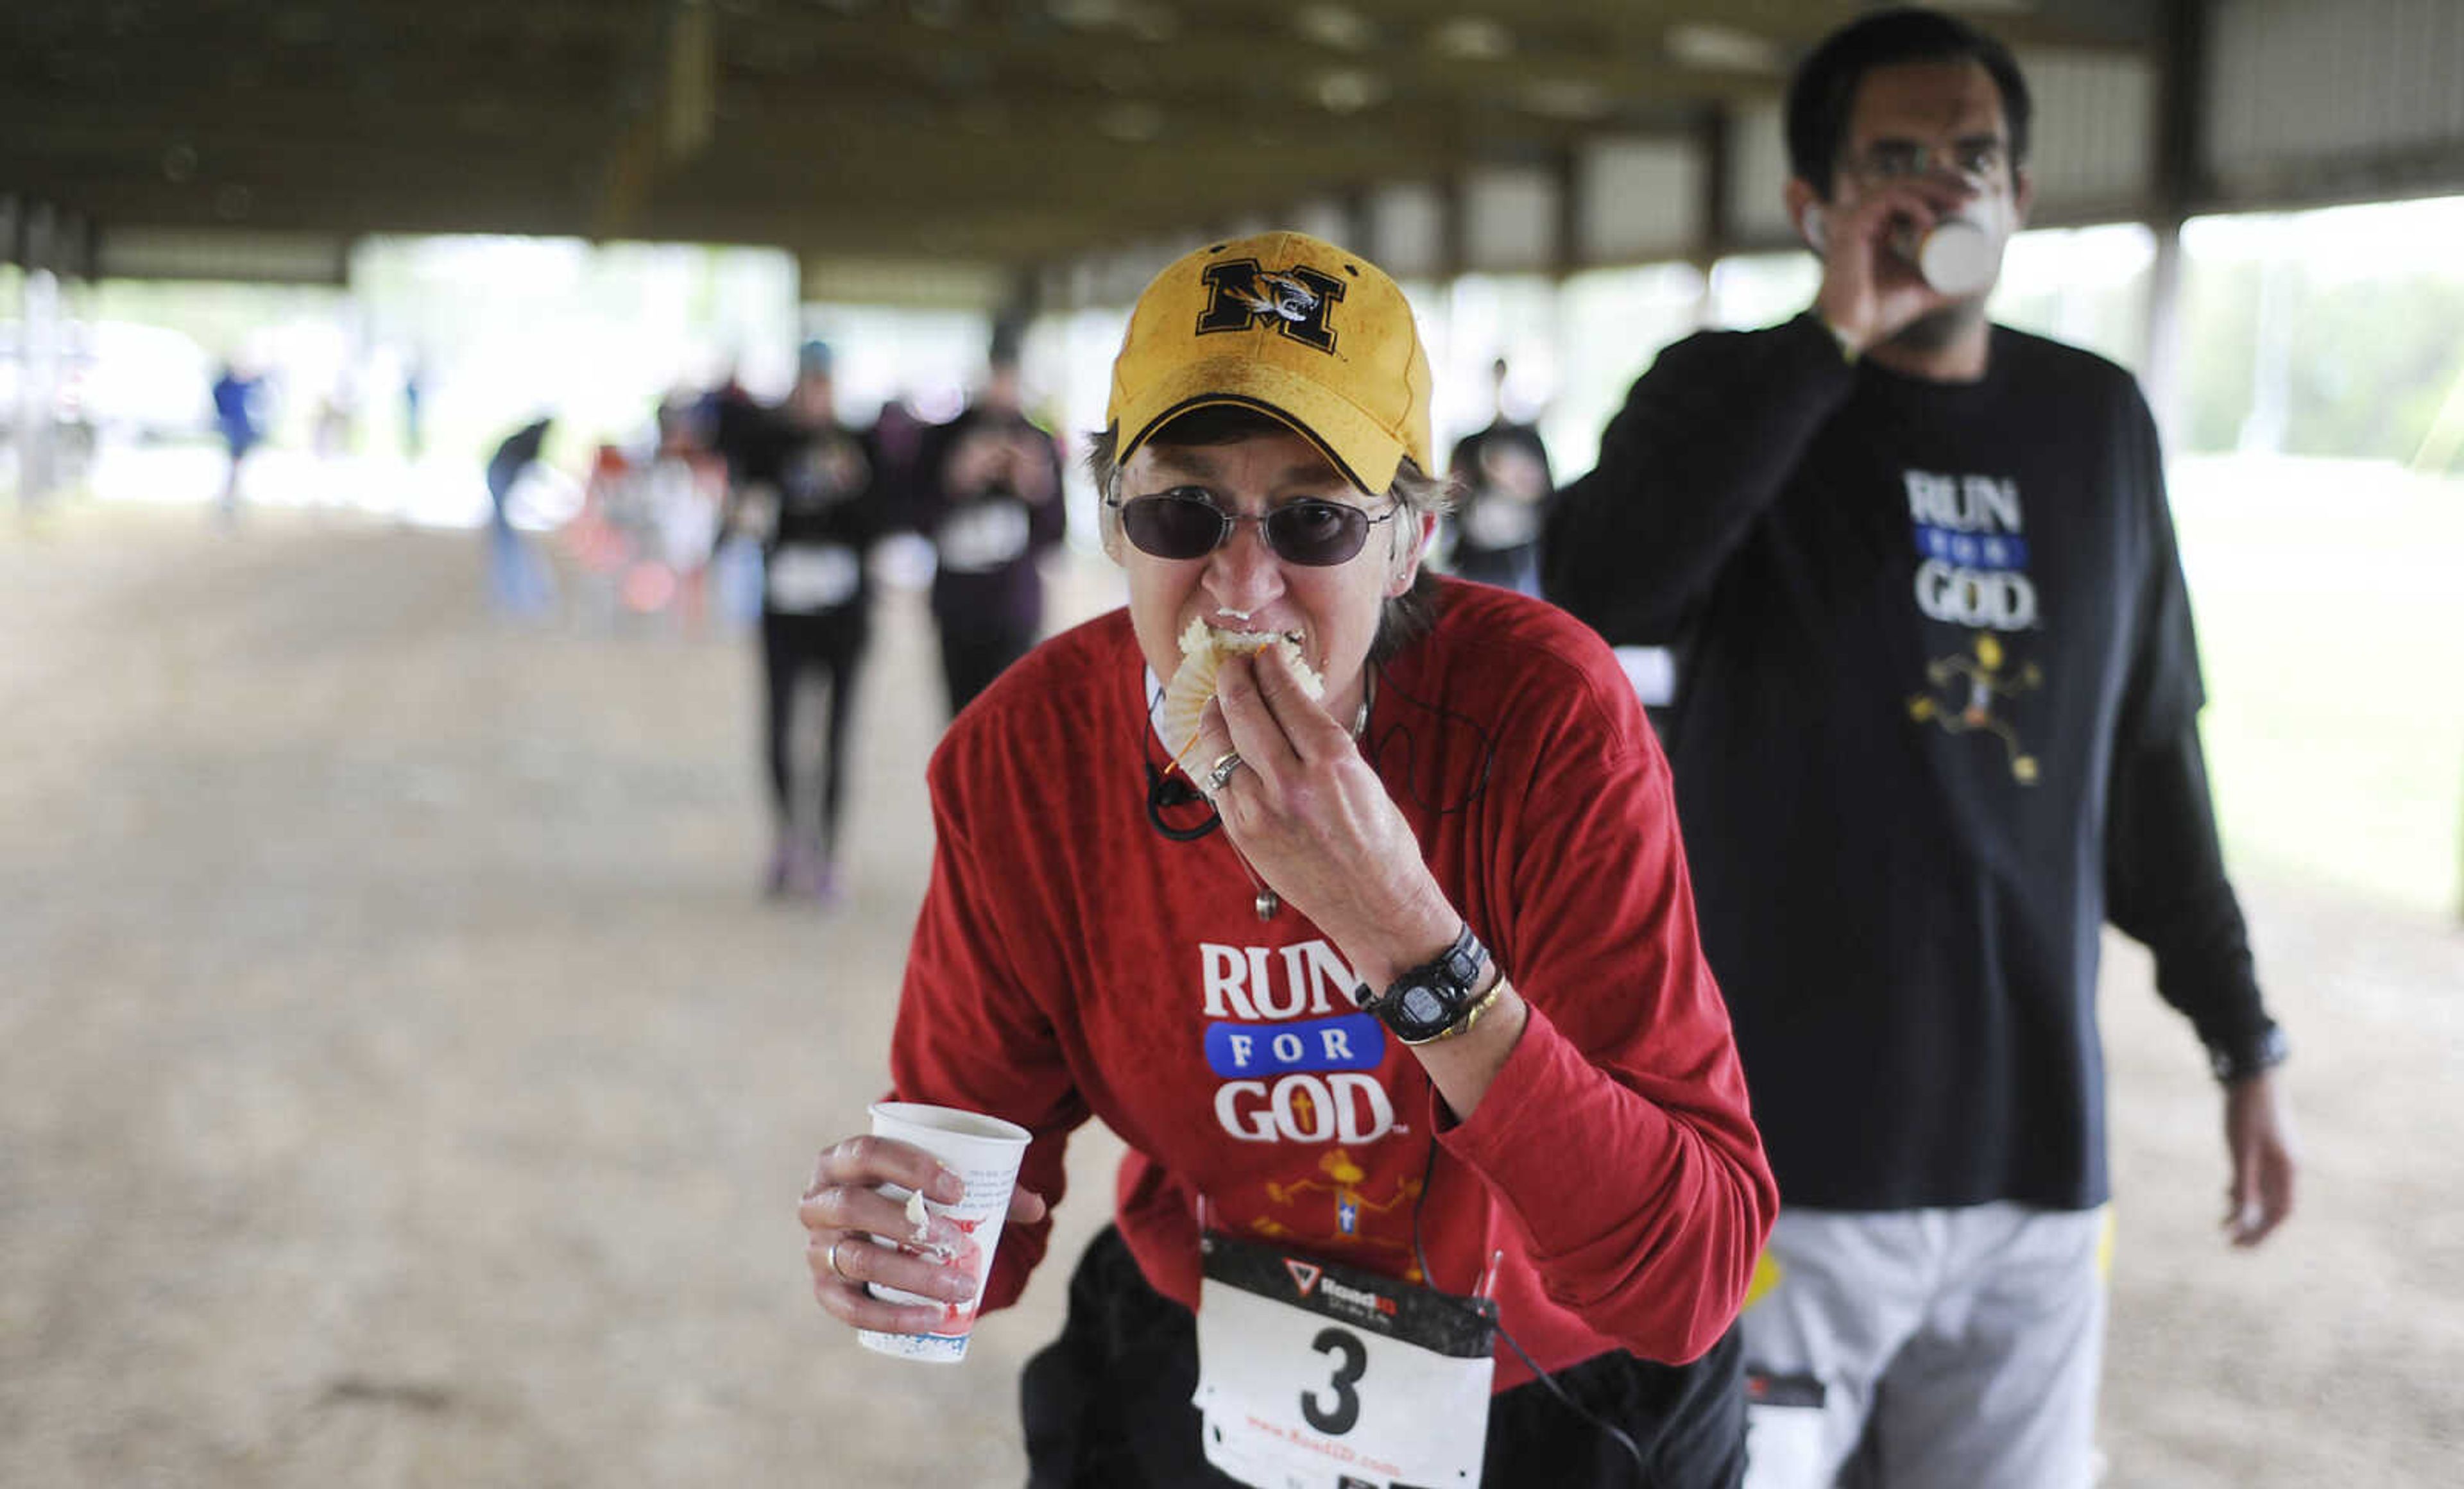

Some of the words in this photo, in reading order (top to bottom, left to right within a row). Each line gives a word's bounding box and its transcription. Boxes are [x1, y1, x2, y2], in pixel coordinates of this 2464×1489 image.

[1195, 258, 1346, 355] M
[1904, 470, 2022, 533] RUN
[1914, 558, 2037, 631] GOD
[1199, 940, 1359, 1019] RUN
[1229, 1028, 1355, 1068] FOR
[1214, 1073, 1395, 1144] GOD
[1301, 1328, 1367, 1435] 3
